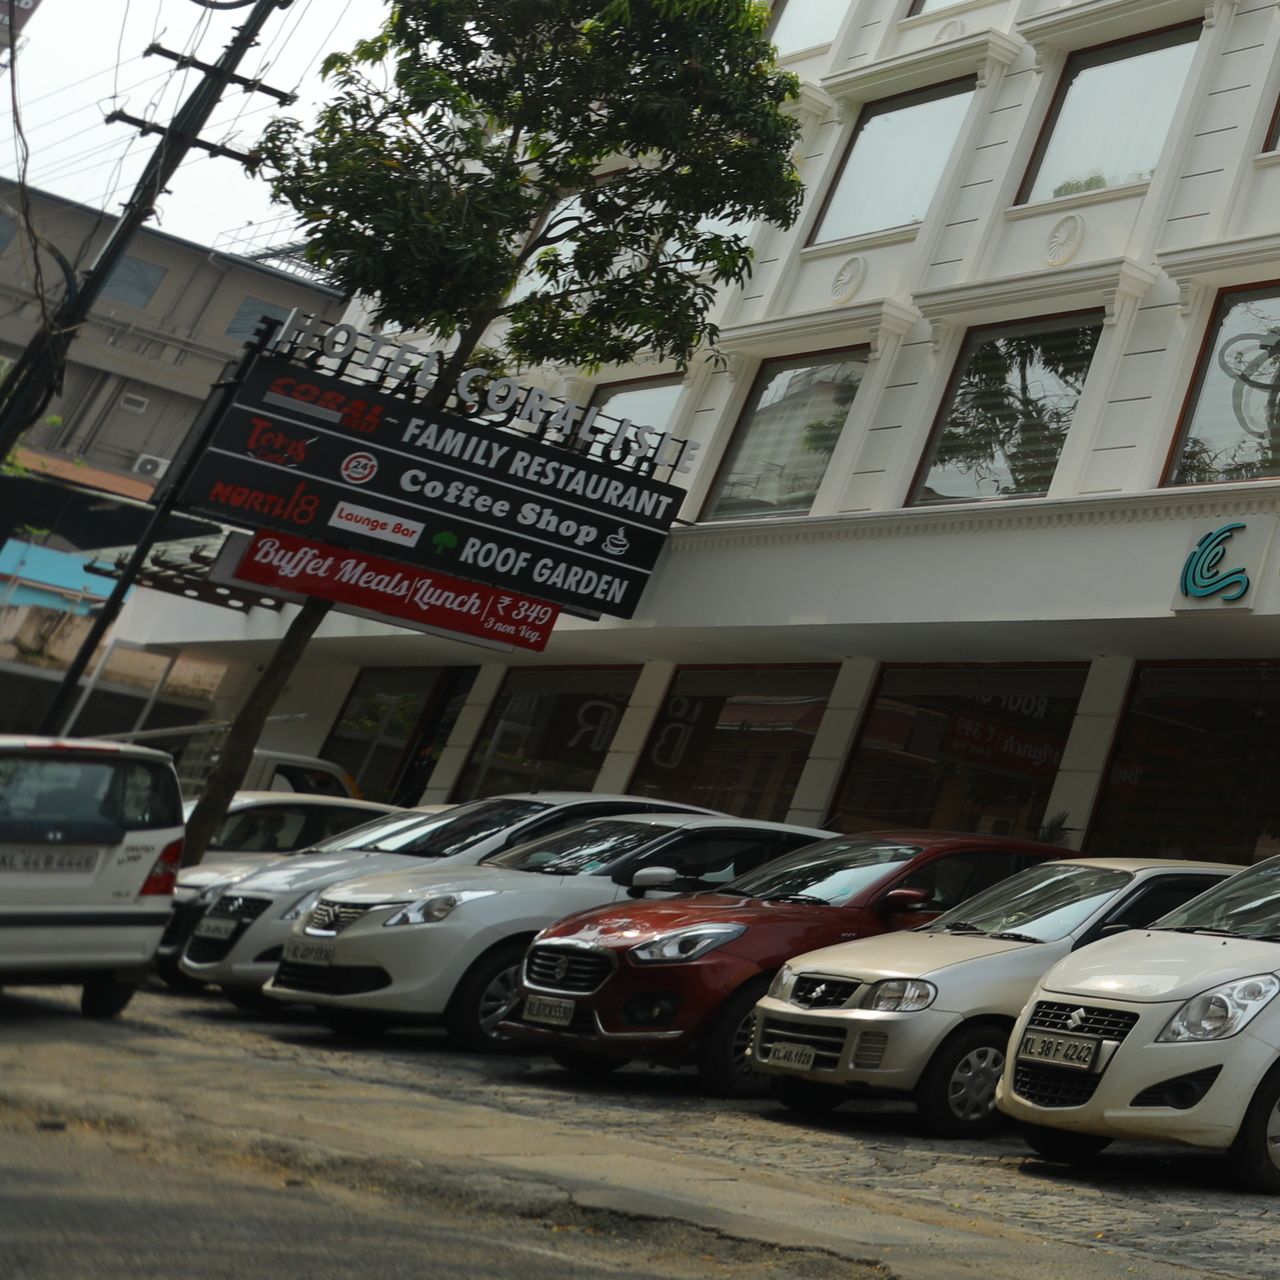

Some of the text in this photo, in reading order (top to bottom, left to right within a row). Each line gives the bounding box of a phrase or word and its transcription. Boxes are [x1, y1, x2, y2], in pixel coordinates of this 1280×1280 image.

[276, 307, 700, 474] HOTEL CORAL ISLE
[401, 417, 673, 520] FAMILY RESTAURANT
[391, 523, 417, 538] Bar
[400, 469, 598, 546] Coffee Shop
[253, 538, 334, 578] Buffet
[511, 599, 553, 625] 349
[459, 537, 629, 604] ROOF GARDEN
[493, 623, 516, 637] non
[517, 625, 542, 642] Veg.
[1021, 1036, 1092, 1063] KL 38 F 4242
